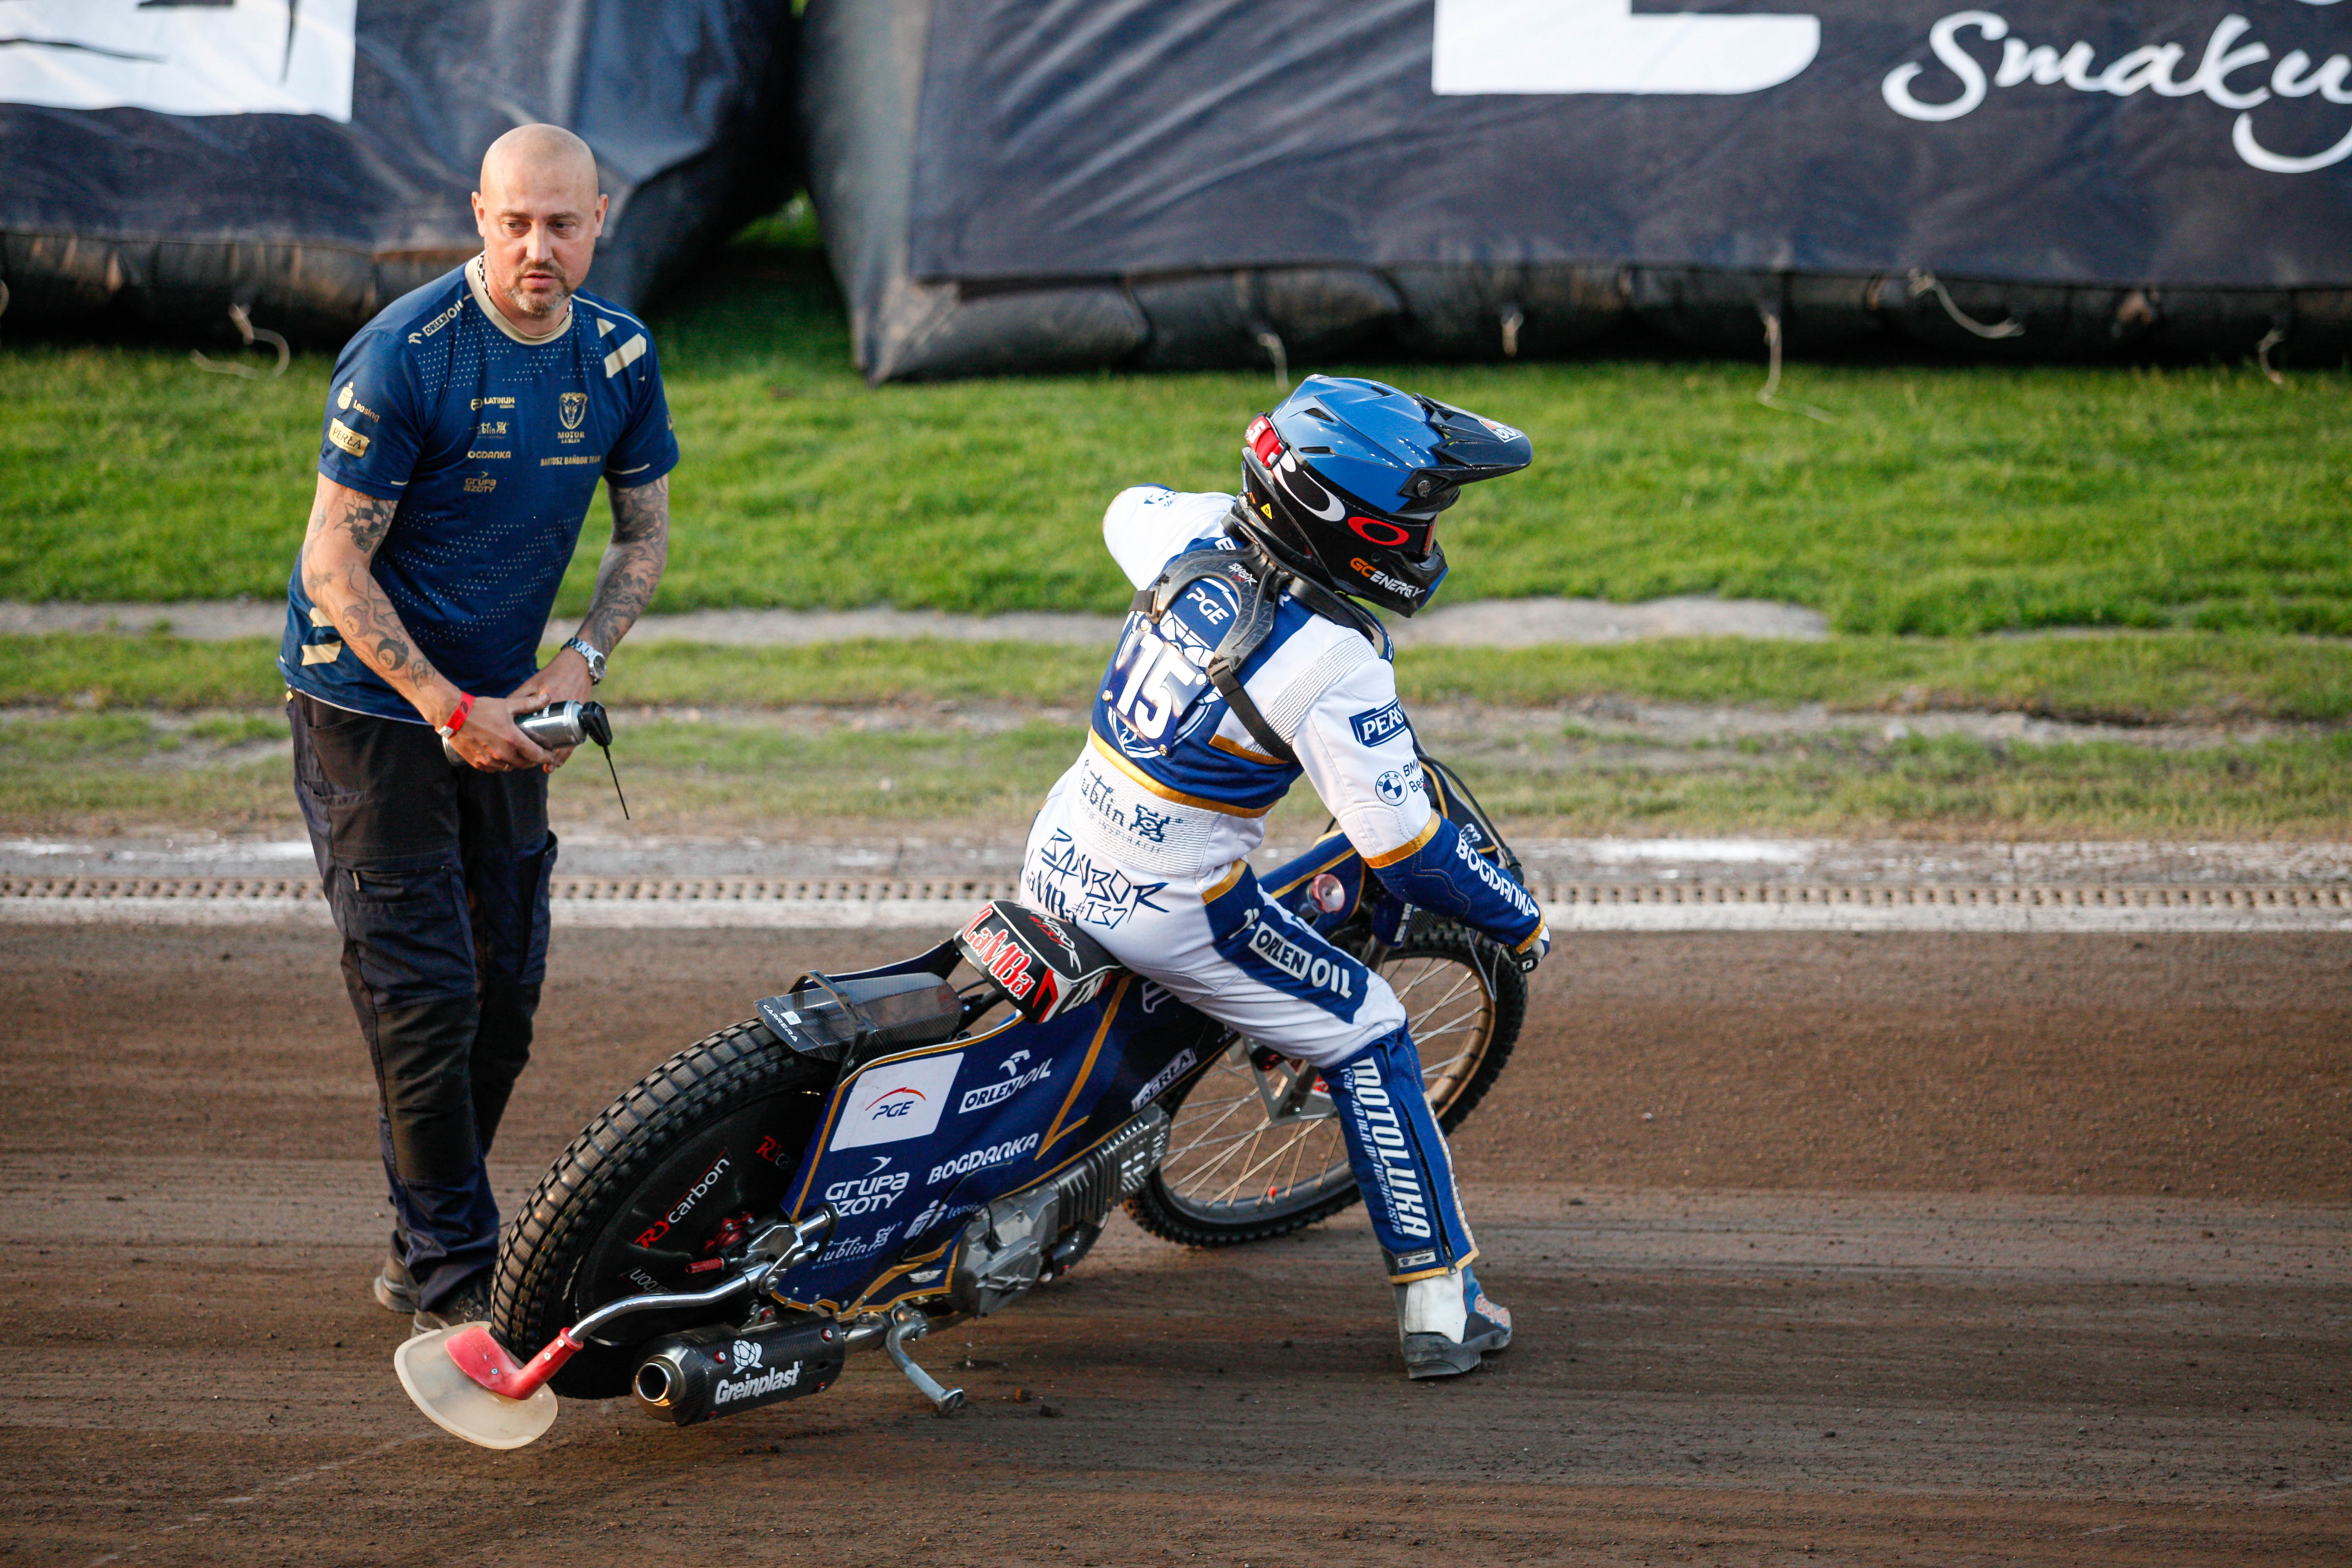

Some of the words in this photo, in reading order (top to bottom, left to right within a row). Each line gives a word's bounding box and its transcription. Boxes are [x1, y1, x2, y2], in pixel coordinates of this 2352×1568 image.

[423, 313, 449, 335] ORLEN
[468, 450, 511, 459] OGDANKA
[541, 456, 563, 467] BARTOSZ
[589, 455, 601, 464] TEAM
[1186, 587, 1229, 625] PGE
[1117, 632, 1197, 739] 15
[1363, 704, 1404, 741] PER
[1080, 769, 1125, 827] ublin
[1456, 833, 1540, 918] BOGDANKA
[1253, 925, 1310, 977] ORLEN
[1310, 958, 1352, 999] OIL
[762, 1004, 799, 1043] CARRERA
[962, 1078, 1022, 1112] ORLEN
[1021, 1057, 1053, 1088] OIL
[872, 1101, 915, 1120] PGE
[926, 1132, 1039, 1186] BOGDANKA
[1350, 1056, 1431, 1238] MOTOLUKA
[714, 1360, 801, 1405] Greinplast
